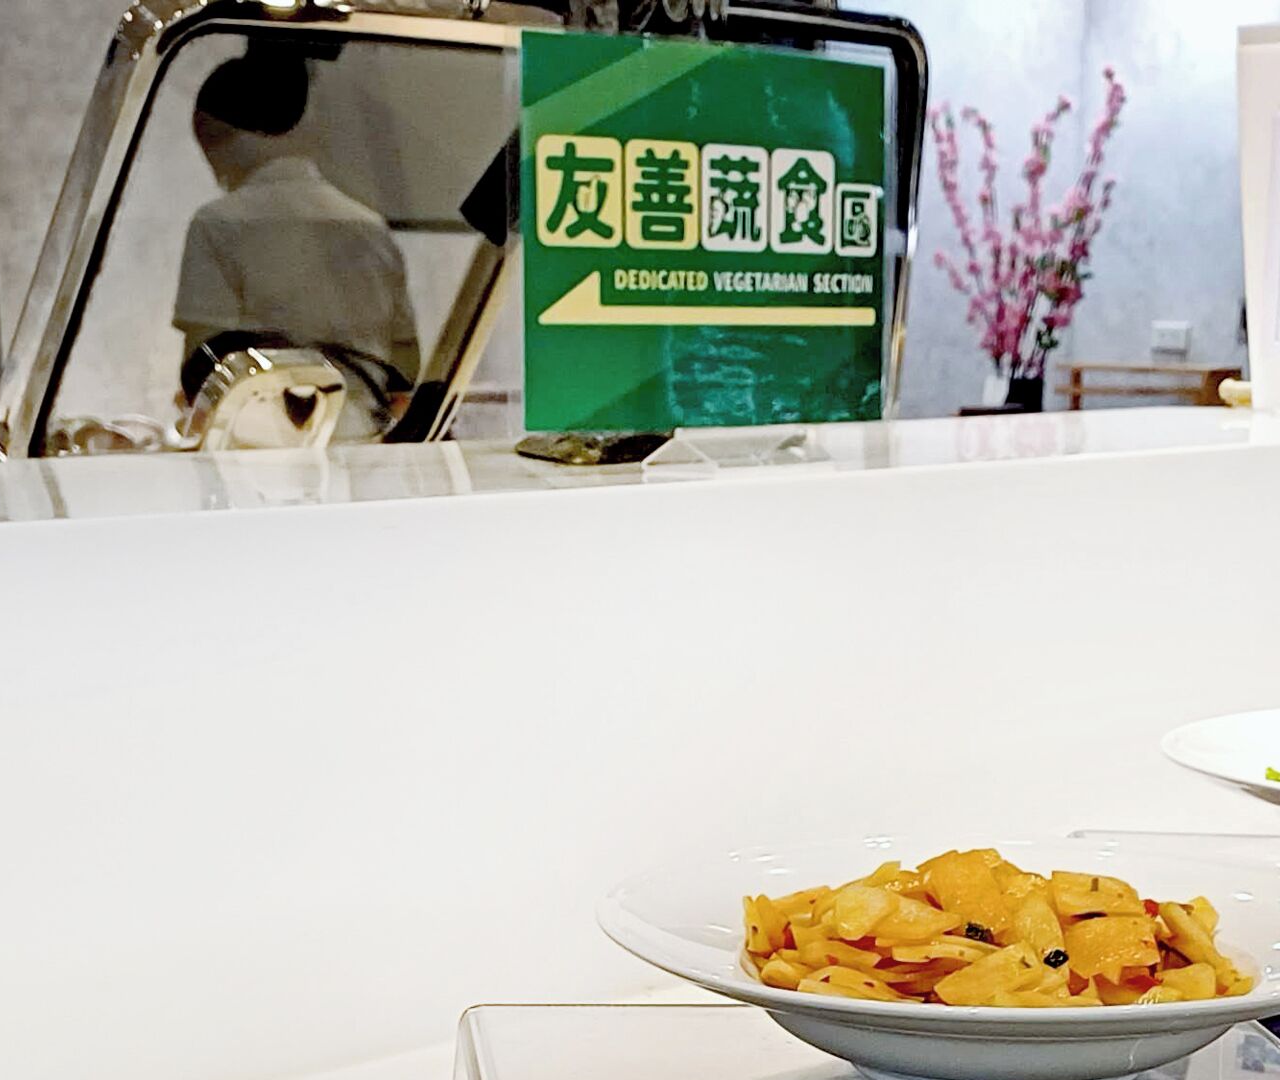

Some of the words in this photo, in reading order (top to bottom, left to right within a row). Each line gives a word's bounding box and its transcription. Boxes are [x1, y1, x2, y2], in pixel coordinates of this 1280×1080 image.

[545, 141, 874, 249] 友善蔬食區
[613, 268, 709, 292] DEDICATED
[713, 270, 809, 293] VEGETARIAN
[812, 272, 874, 295] SECTION
